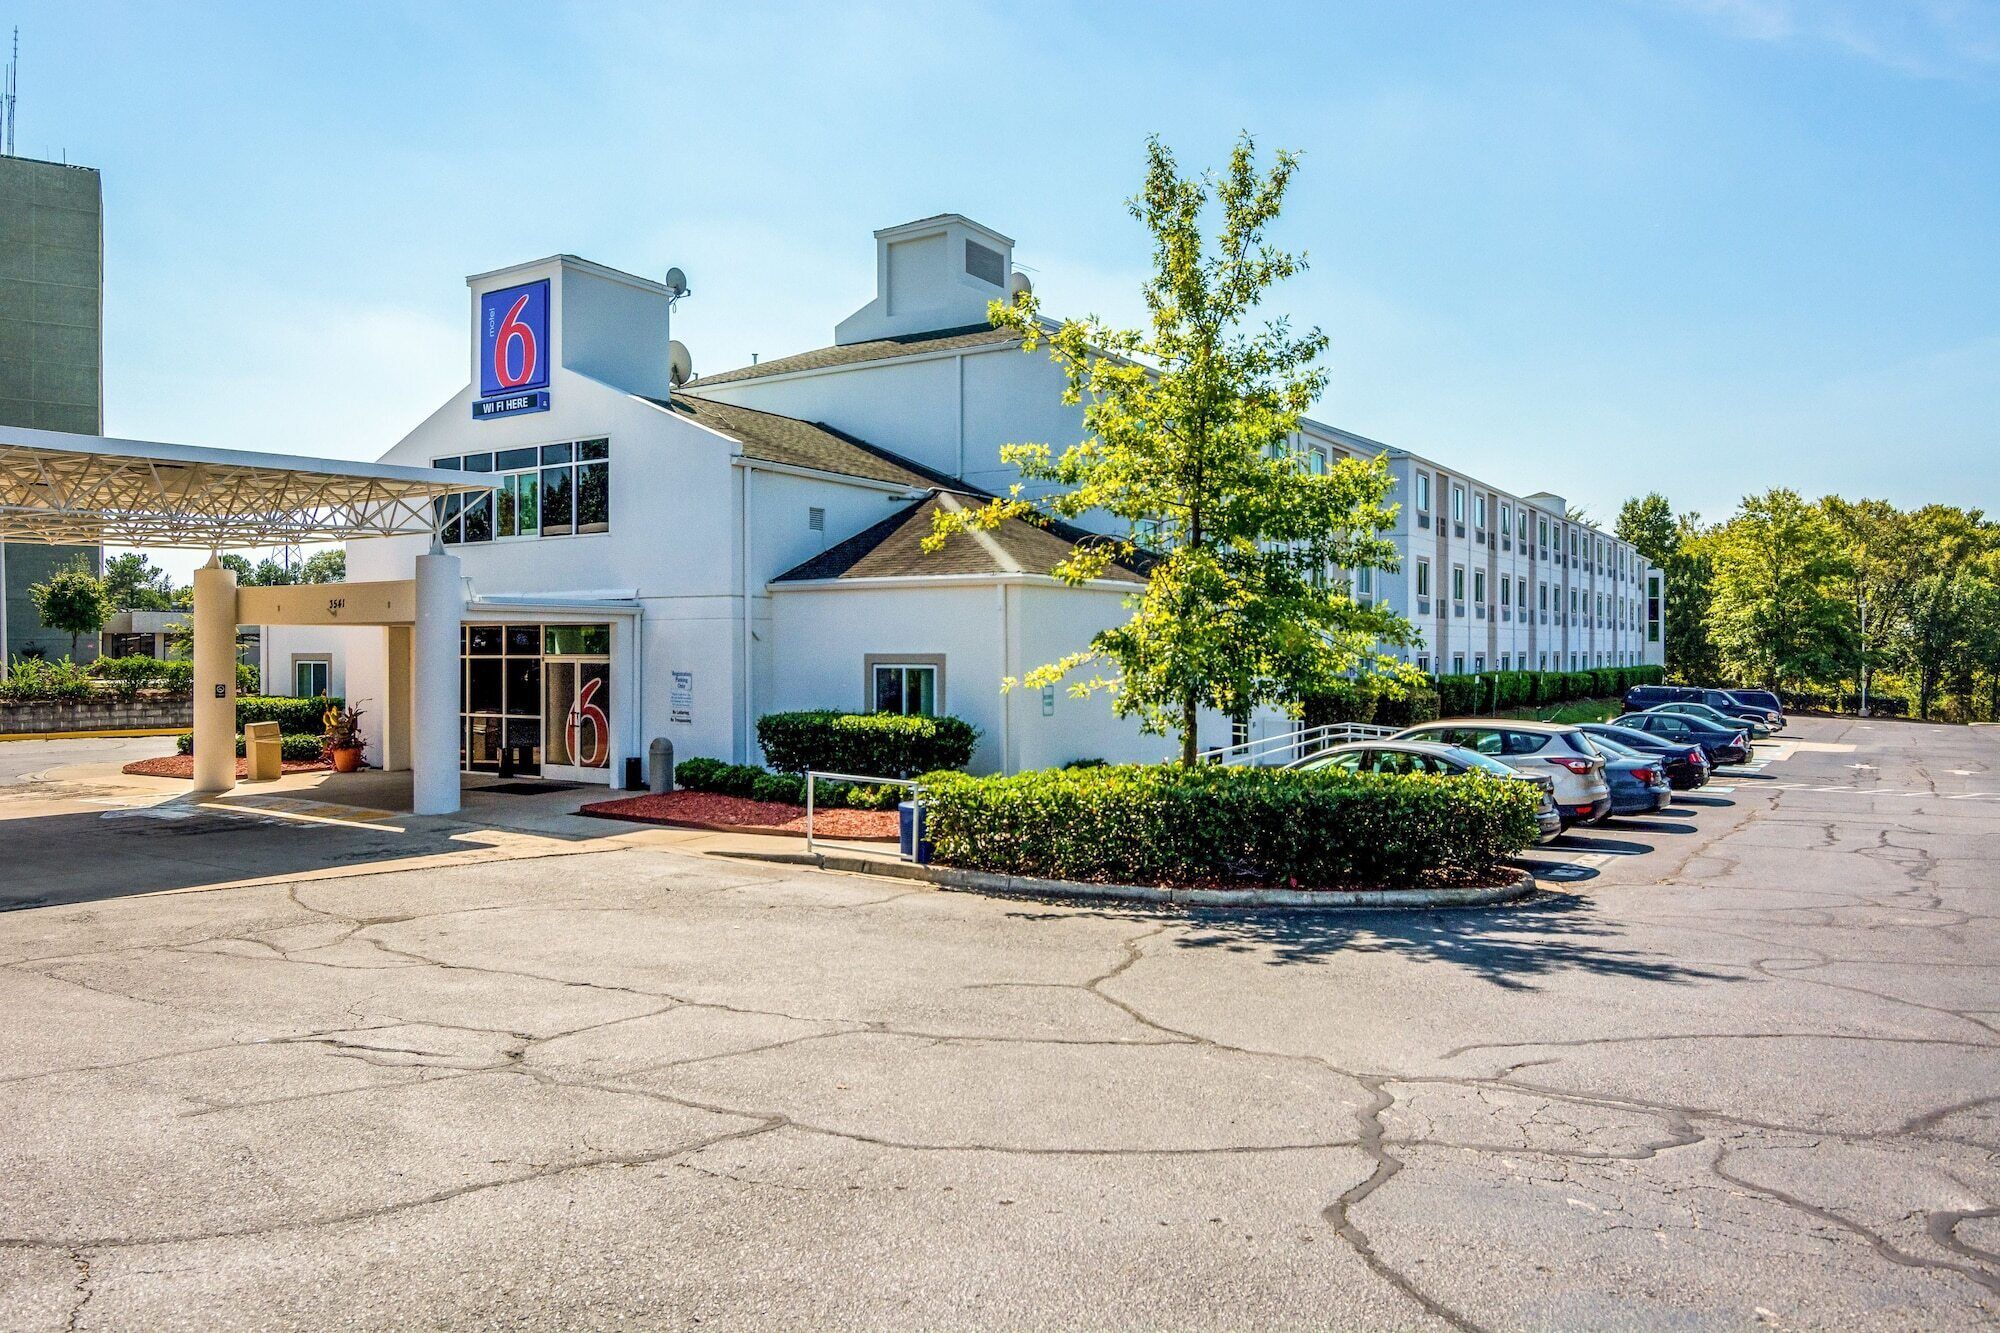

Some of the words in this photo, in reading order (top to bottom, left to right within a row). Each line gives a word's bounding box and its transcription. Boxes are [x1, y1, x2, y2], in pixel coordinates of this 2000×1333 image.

[494, 293, 537, 388] 6
[483, 402, 494, 413] WI
[496, 401, 504, 412] FI
[506, 397, 528, 410] HERE
[329, 598, 345, 609] 3541
[565, 677, 610, 768] 6
